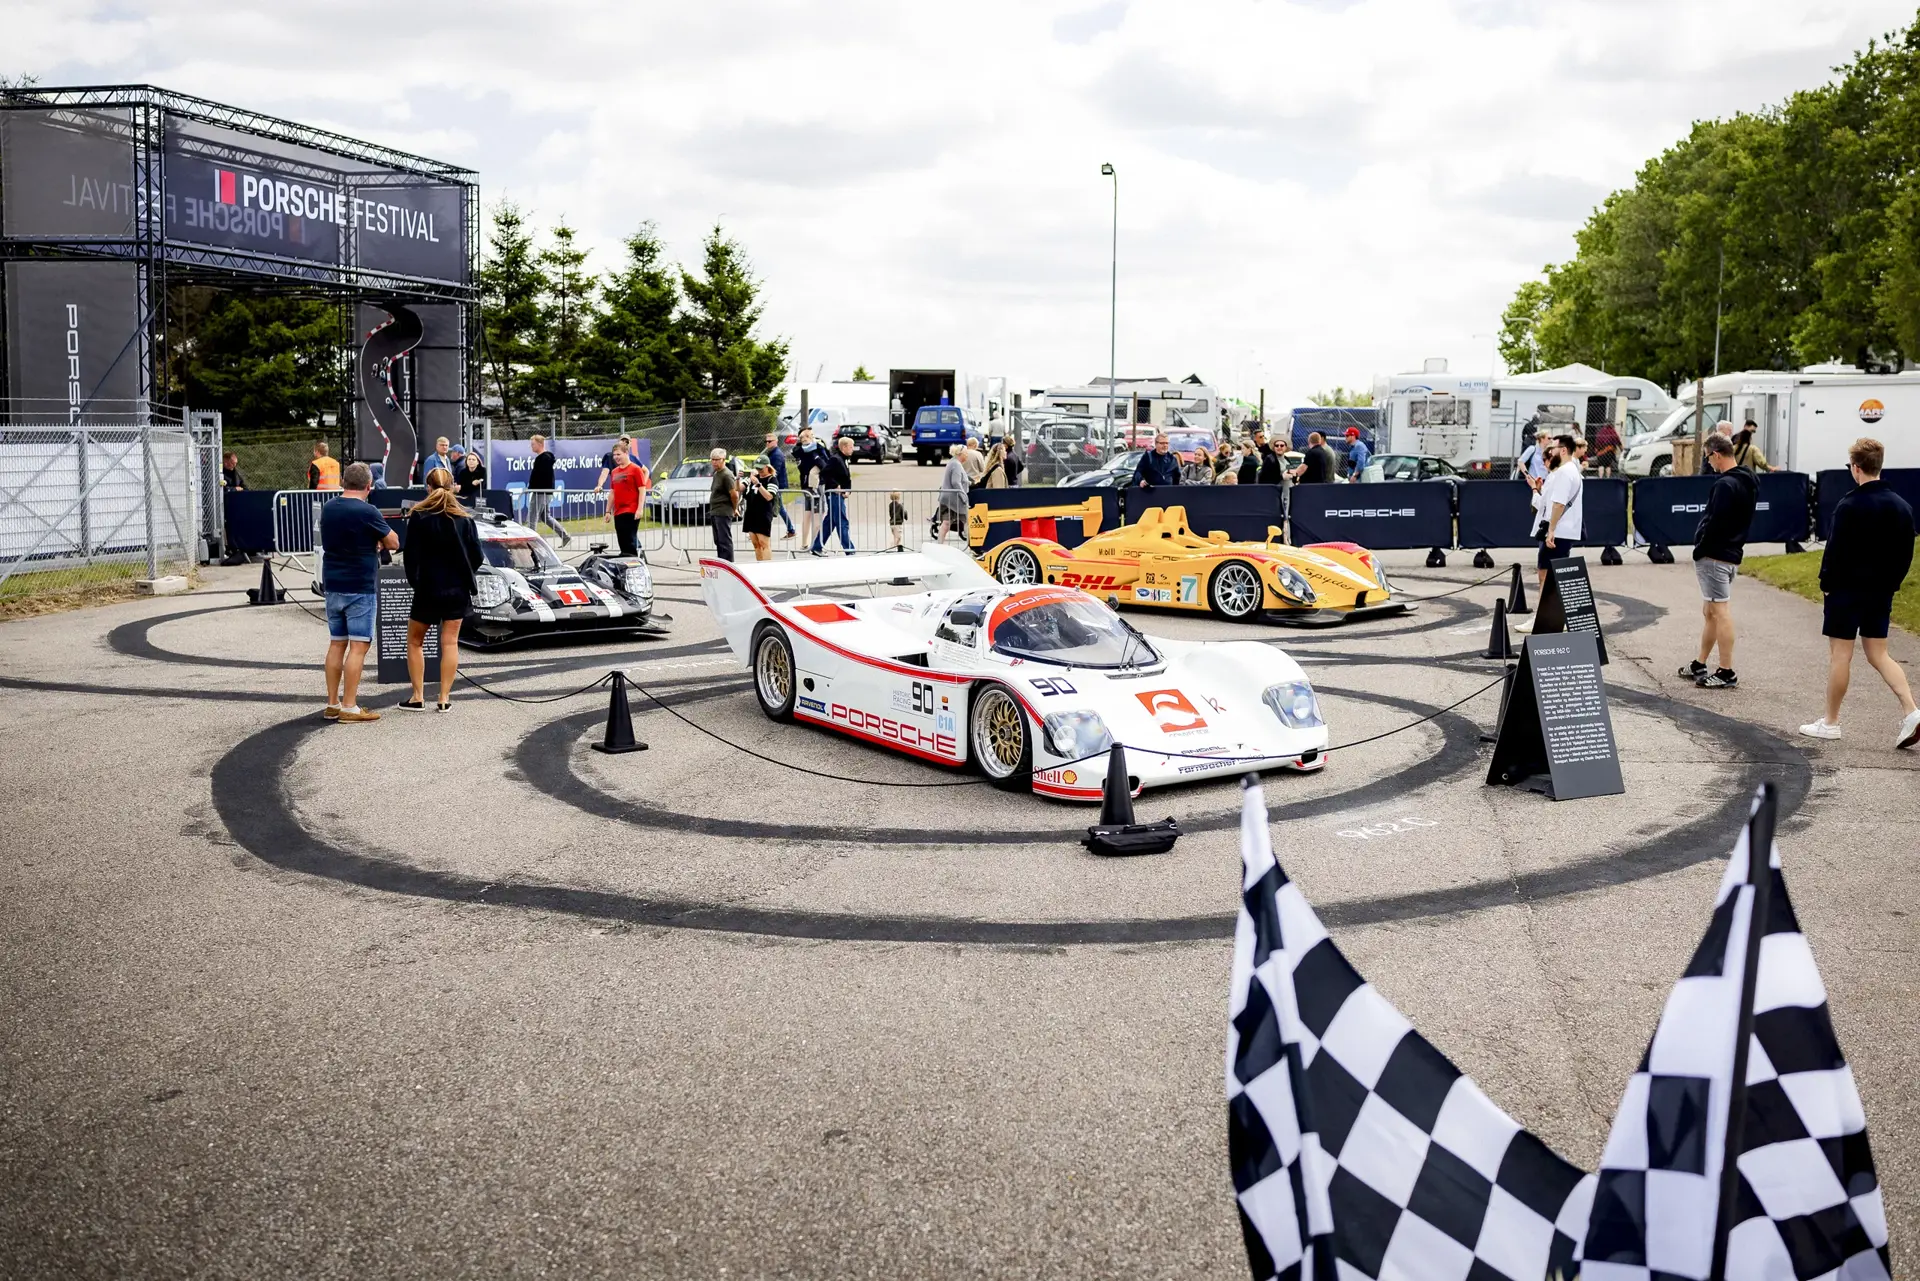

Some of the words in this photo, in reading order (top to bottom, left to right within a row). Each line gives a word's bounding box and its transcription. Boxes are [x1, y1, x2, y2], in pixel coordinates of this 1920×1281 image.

[243, 174, 347, 226] PORSCHE
[353, 197, 440, 243] FESTIVAL
[506, 456, 525, 471] Tak
[579, 456, 594, 469] Kør
[1325, 508, 1416, 518] PORSCHE
[1060, 572, 1121, 591] DHL
[1300, 567, 1356, 591] Spyder
[564, 589, 583, 603] 1
[1161, 591, 1171, 600] P2
[1181, 577, 1197, 601] 7
[1533, 648, 1556, 656] PORSCHE
[1556, 647, 1565, 655] 962
[1028, 676, 1078, 697] 90
[802, 699, 823, 711] RAVENOL
[892, 694, 911, 706] RACING
[912, 681, 934, 715] 90
[831, 703, 956, 756] PORSCHE
[938, 714, 953, 732] C1A
[1033, 765, 1061, 784] Shell
